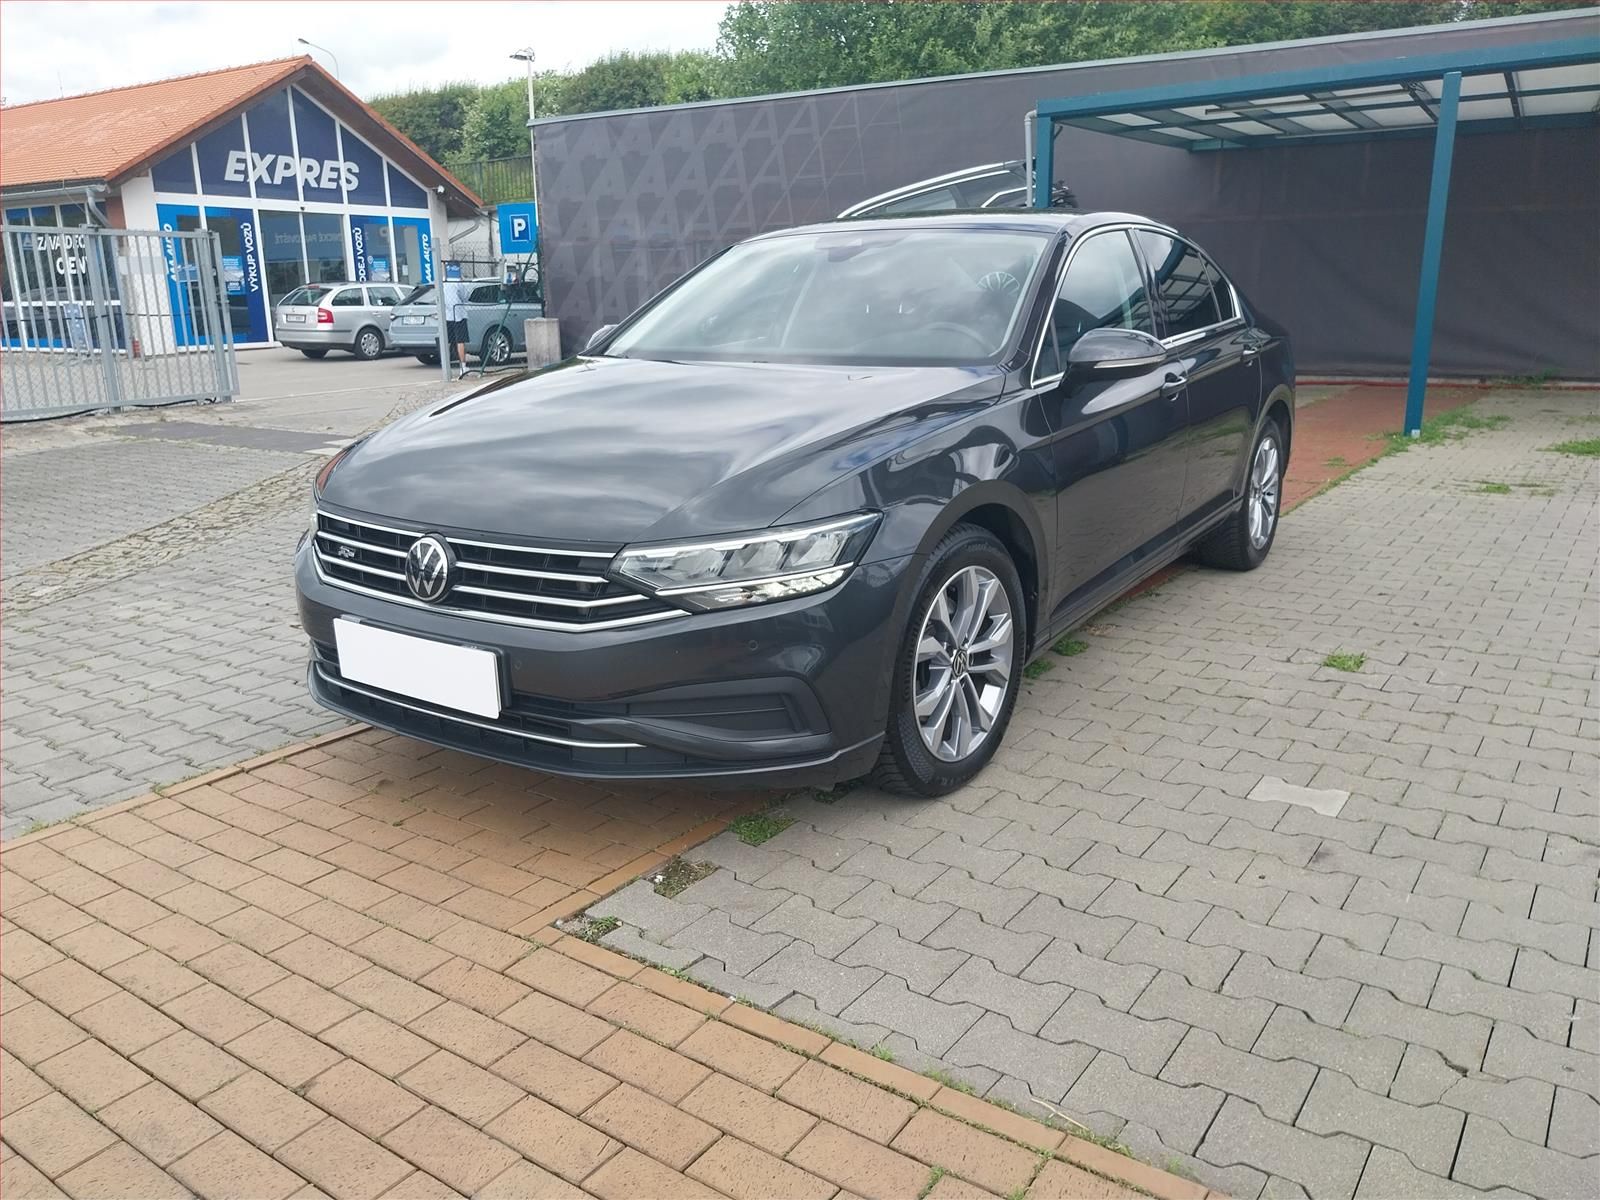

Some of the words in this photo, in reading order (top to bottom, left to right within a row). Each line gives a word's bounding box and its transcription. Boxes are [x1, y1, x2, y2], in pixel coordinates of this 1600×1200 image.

[224, 150, 360, 191] EXPRES
[240, 222, 254, 253] VOZŮ
[352, 227, 364, 255] VOZŮ
[421, 233, 431, 262] AUTO
[247, 254, 259, 292] VÝKUP
[357, 256, 367, 282] ODEJ
